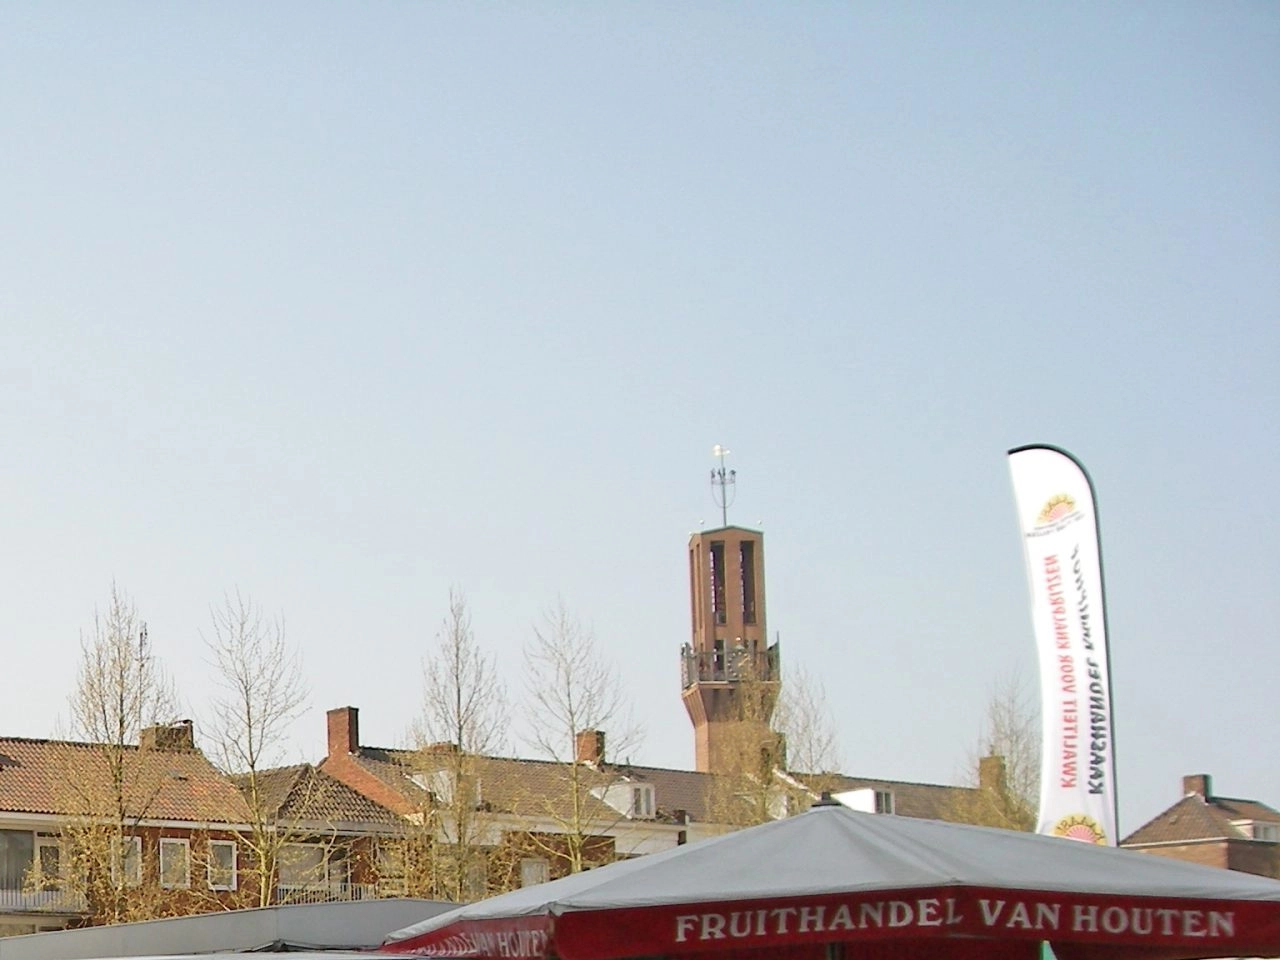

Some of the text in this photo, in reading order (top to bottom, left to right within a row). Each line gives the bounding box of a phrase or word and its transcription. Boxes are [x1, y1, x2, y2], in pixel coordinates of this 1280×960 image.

[675, 898, 1236, 942] FRUITHANDEL VAN HOUTEN
